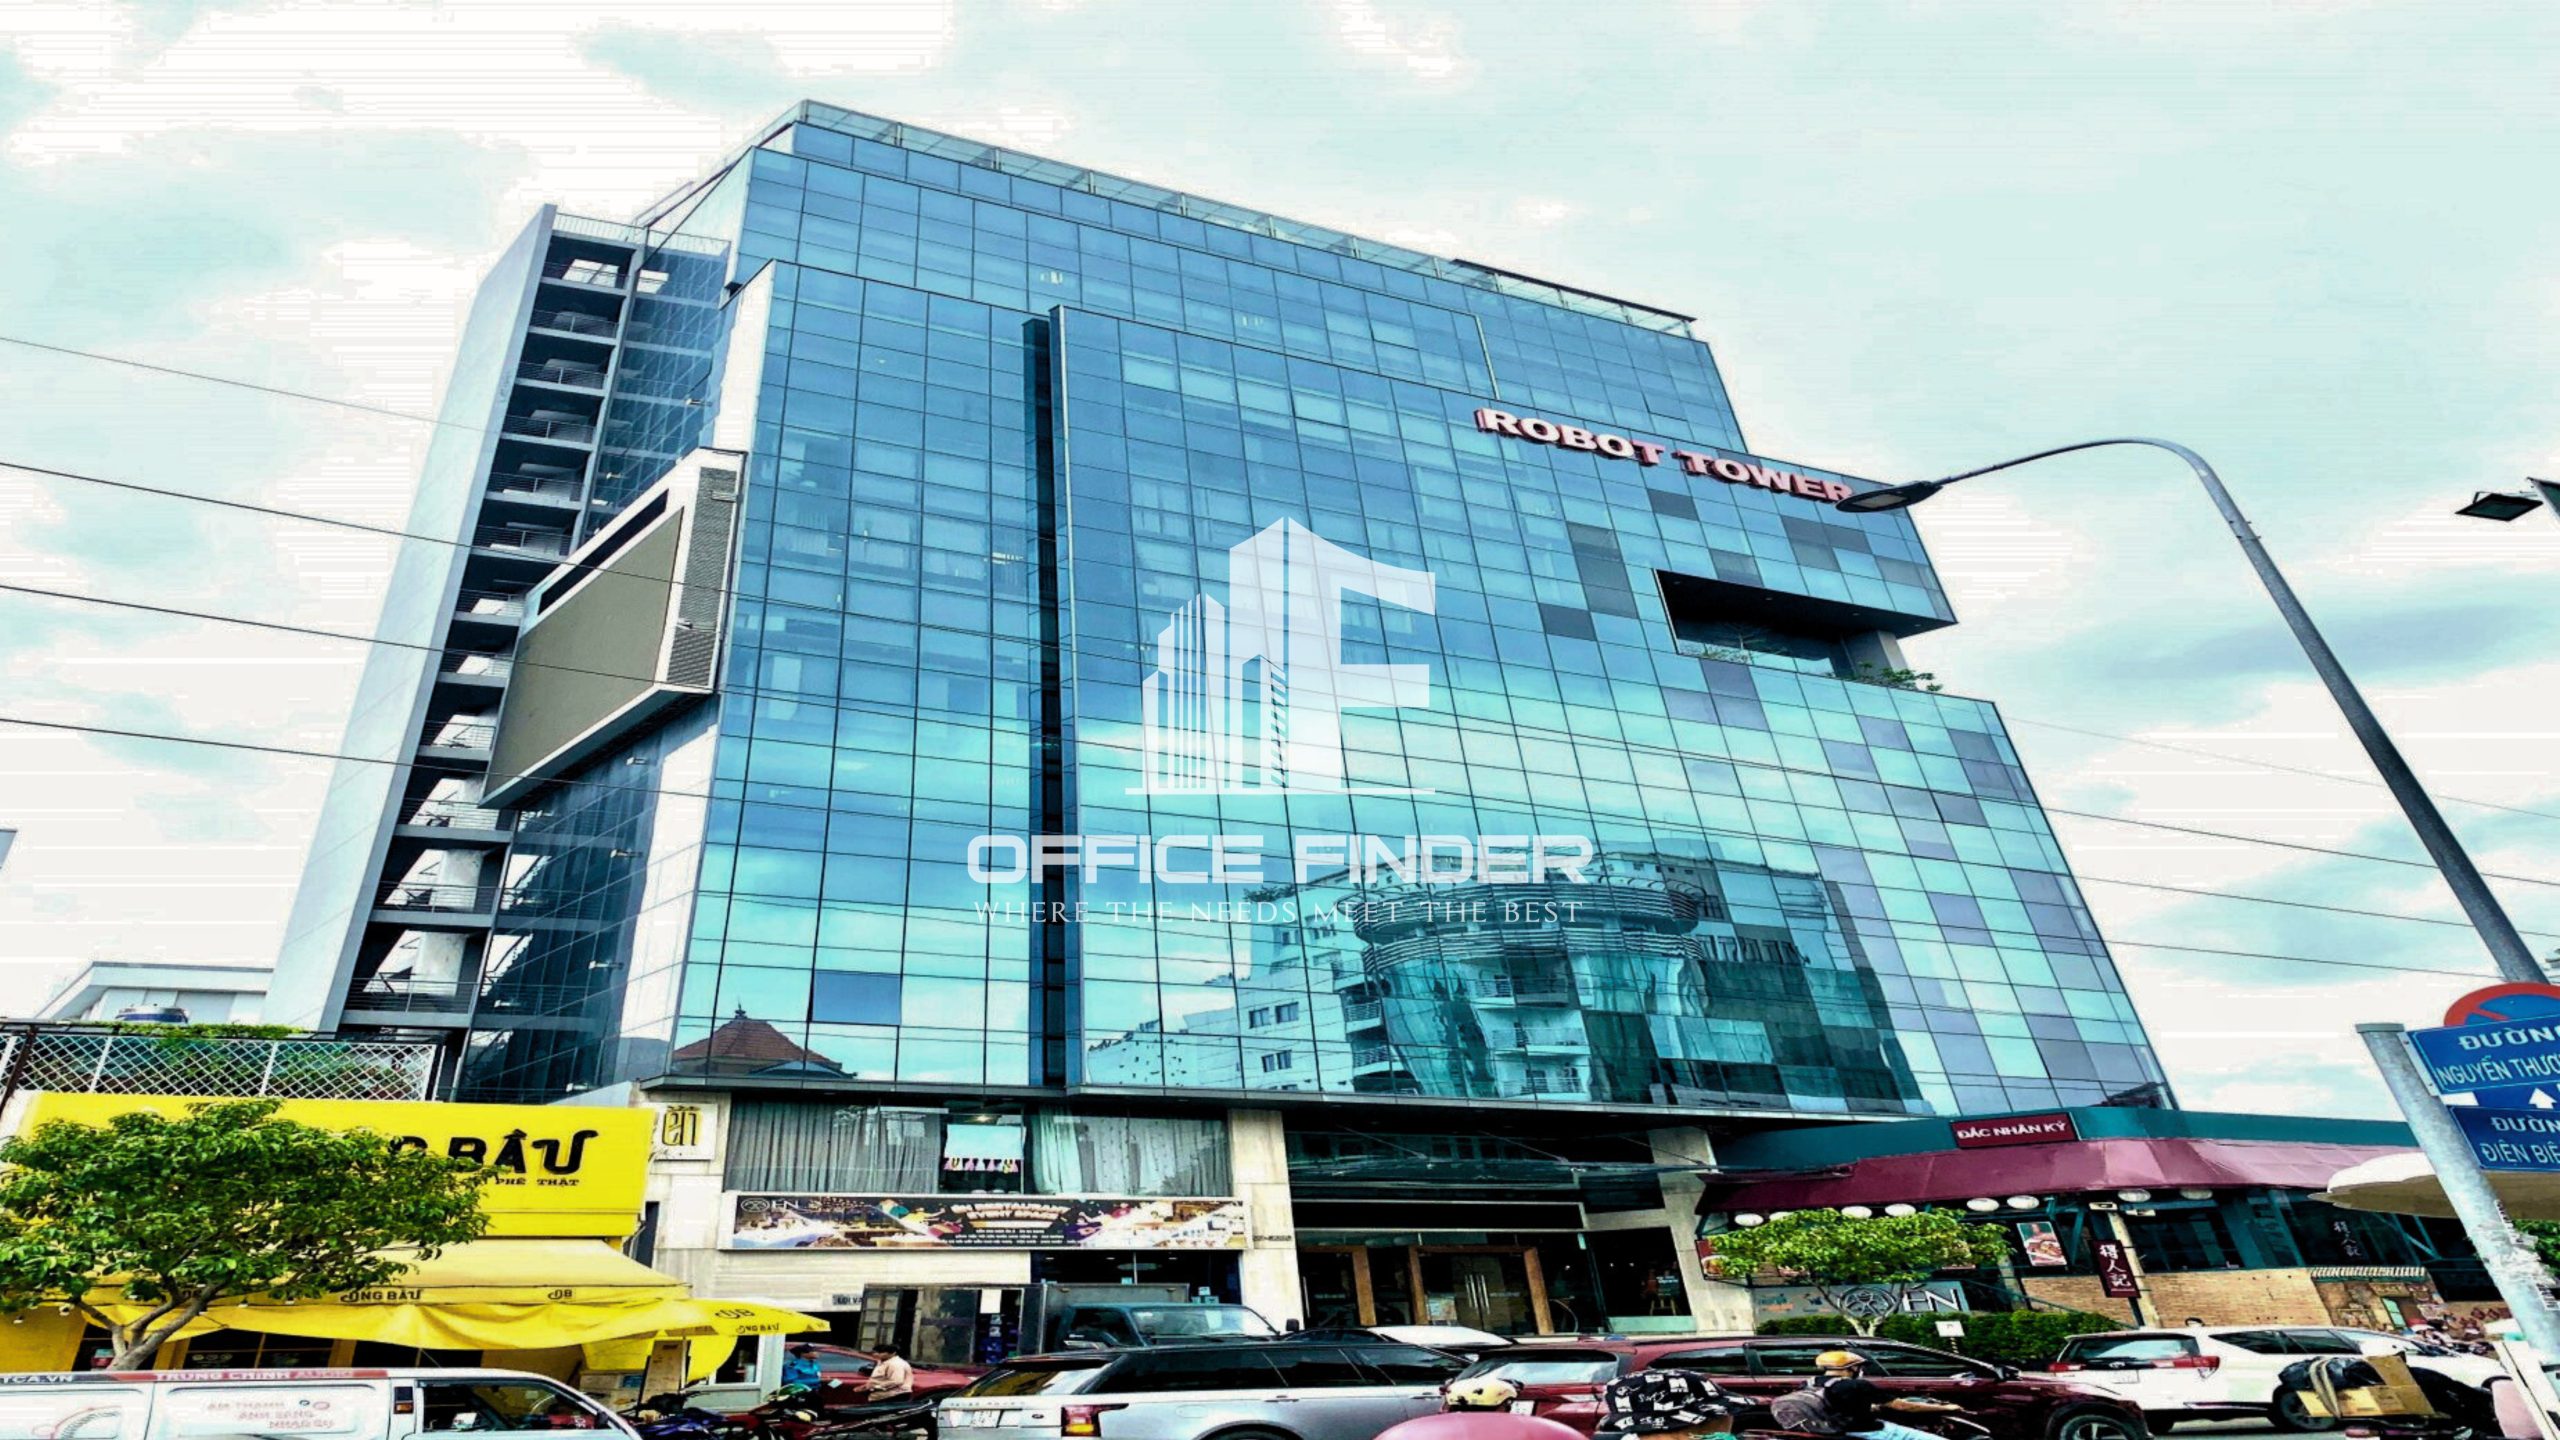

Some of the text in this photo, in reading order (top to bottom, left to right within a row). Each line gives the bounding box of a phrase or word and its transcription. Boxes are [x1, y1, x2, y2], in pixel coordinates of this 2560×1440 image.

[1475, 407, 1854, 503] ROBOT TOWER
[2458, 1025, 2560, 1050] ĐƯỜN
[2435, 1055, 2513, 1086] NGUYỄN
[2480, 1138, 2531, 1167] ĐIỆN
